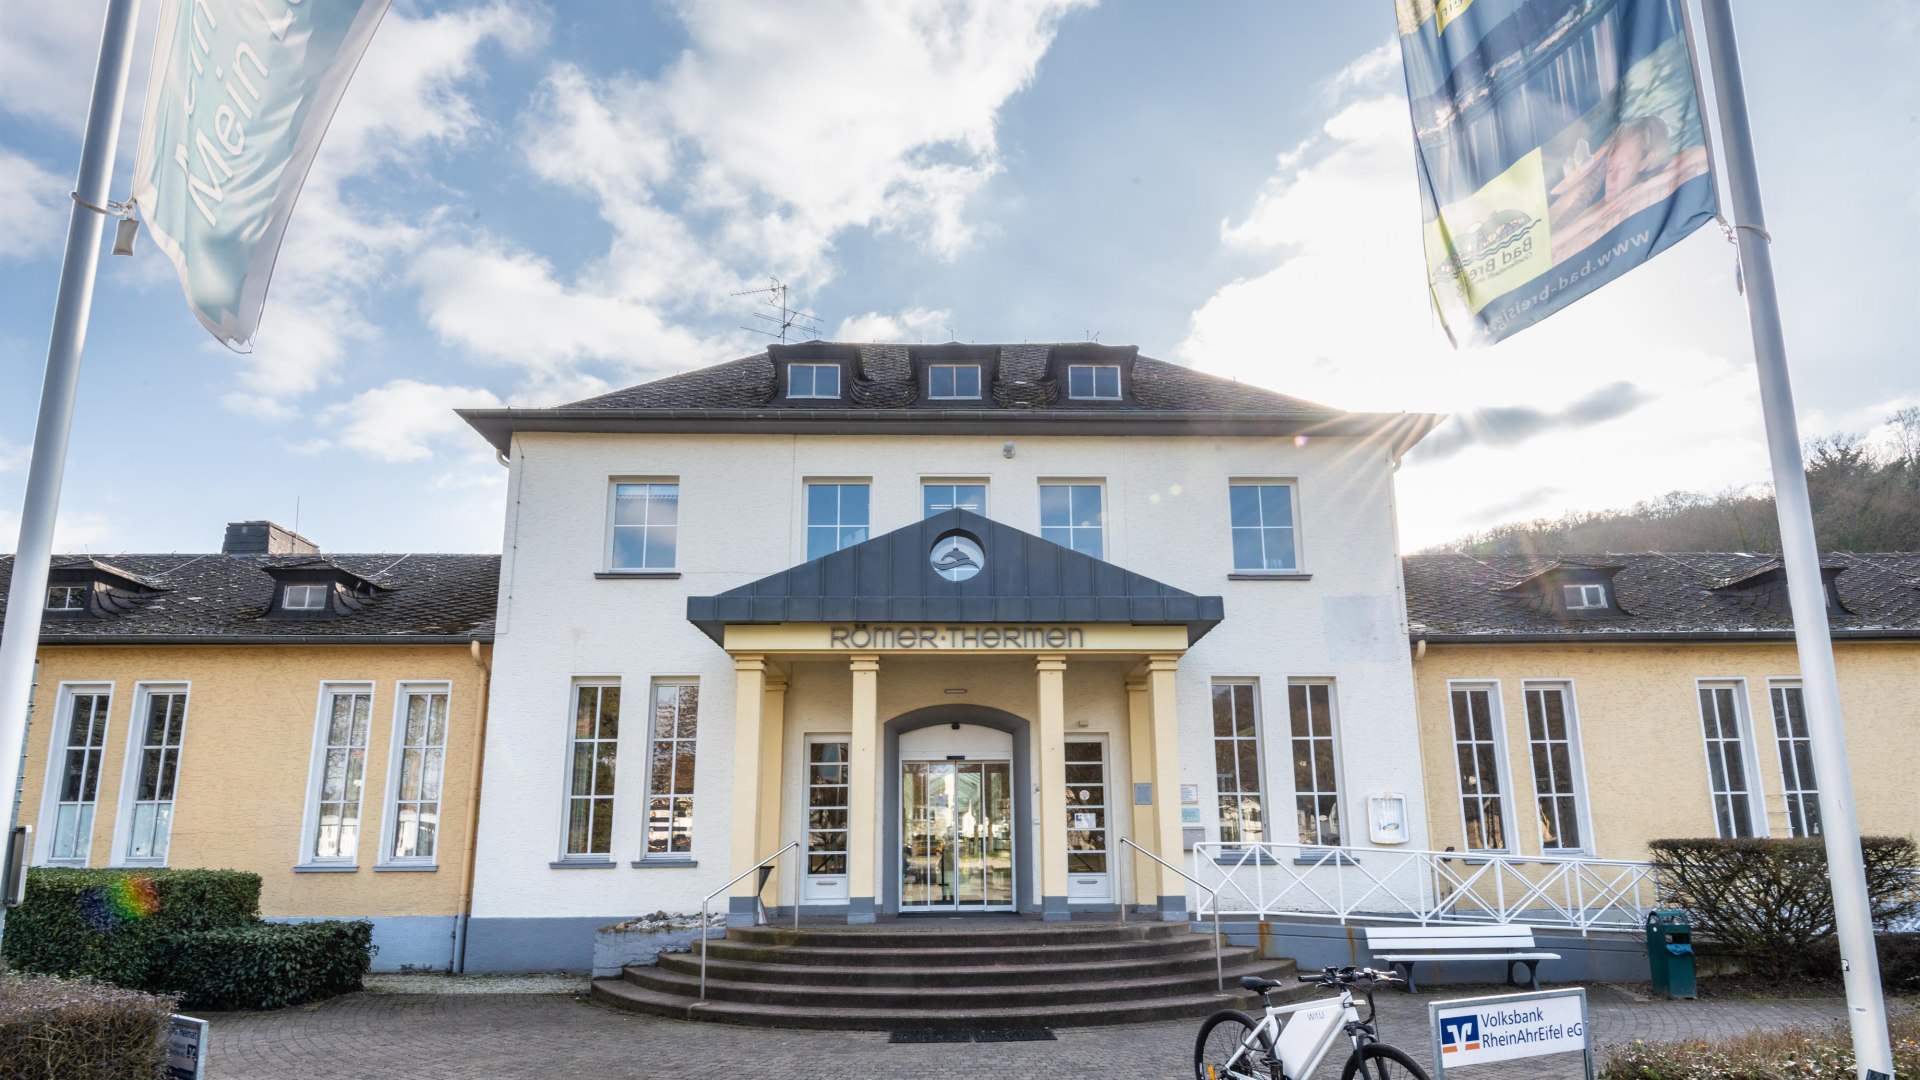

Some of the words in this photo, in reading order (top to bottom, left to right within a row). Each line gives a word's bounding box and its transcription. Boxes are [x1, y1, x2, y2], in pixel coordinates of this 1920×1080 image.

[174, 41, 268, 227] Mein
[1481, 1006, 1544, 1028] Volksbank
[1482, 1023, 1563, 1049] RheinAhrEifel
[1566, 1022, 1583, 1037] eG
